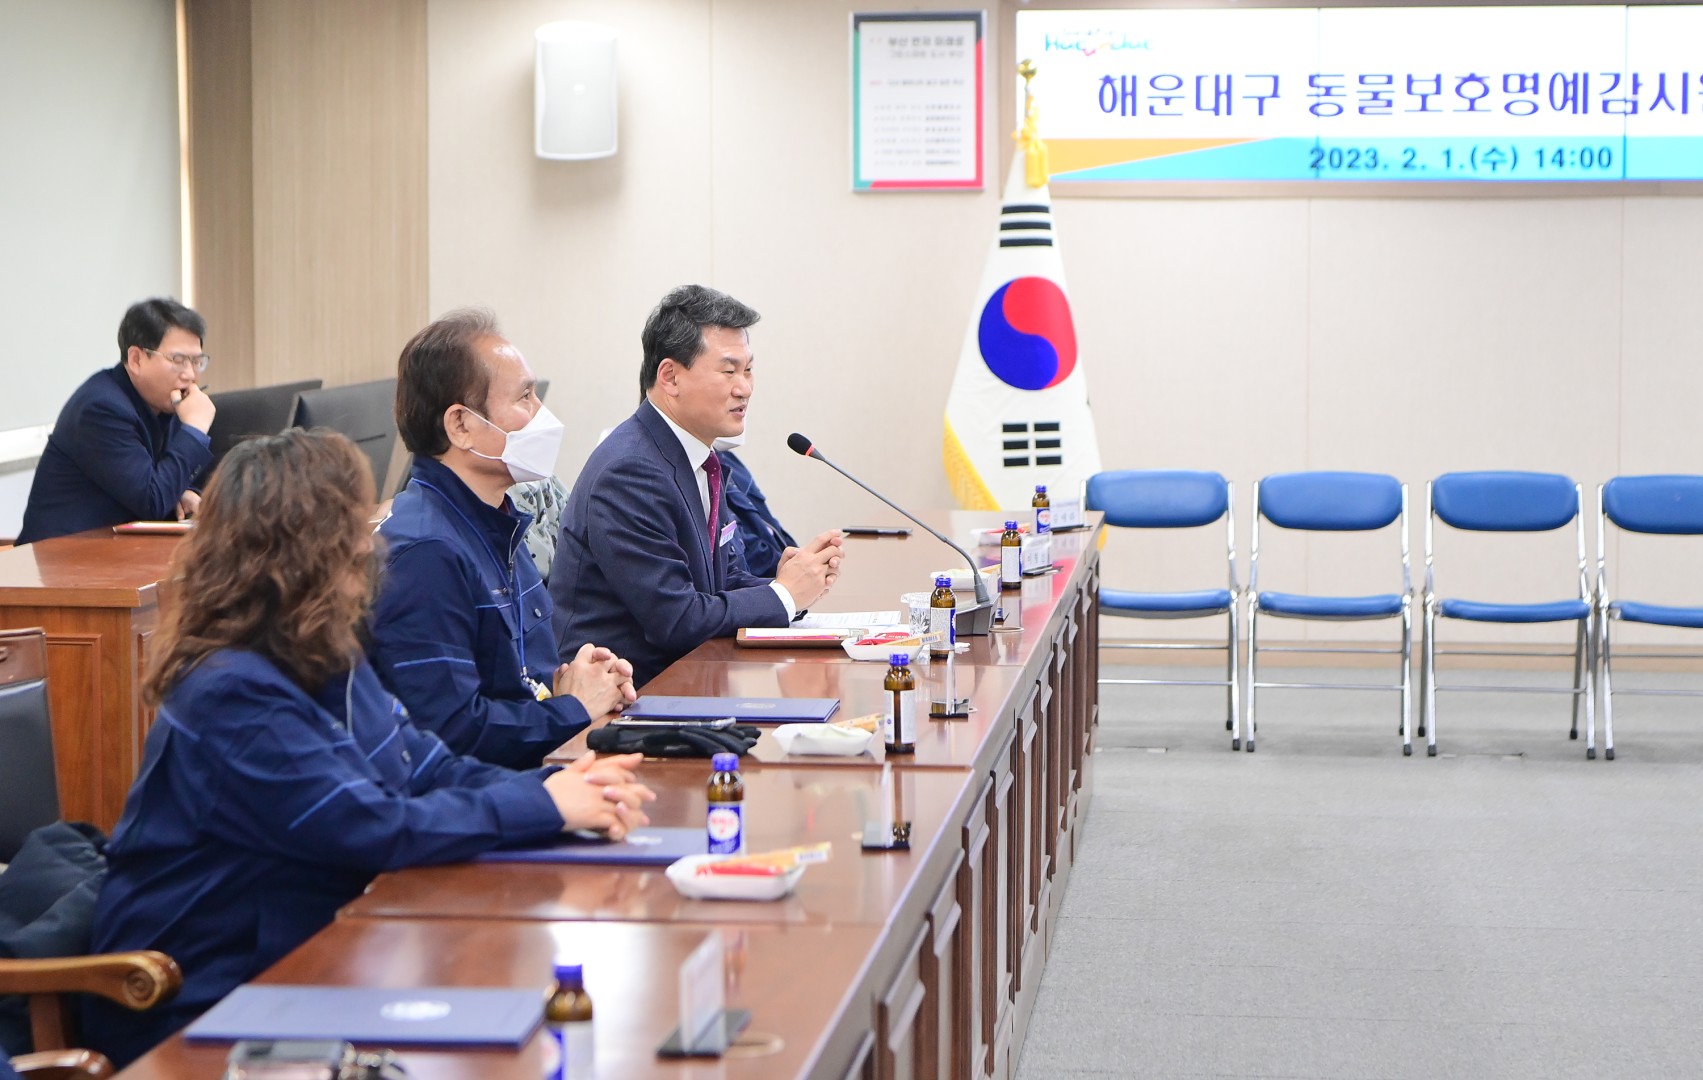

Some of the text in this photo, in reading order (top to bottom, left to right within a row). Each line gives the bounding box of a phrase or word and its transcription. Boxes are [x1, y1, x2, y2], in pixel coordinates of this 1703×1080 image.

[1098, 72, 1703, 117] 해운대구 동물보호명예감시
[1309, 147, 1389, 170] 2023.
[1402, 147, 1426, 170] 2.
[1535, 147, 1613, 169] 14:00
